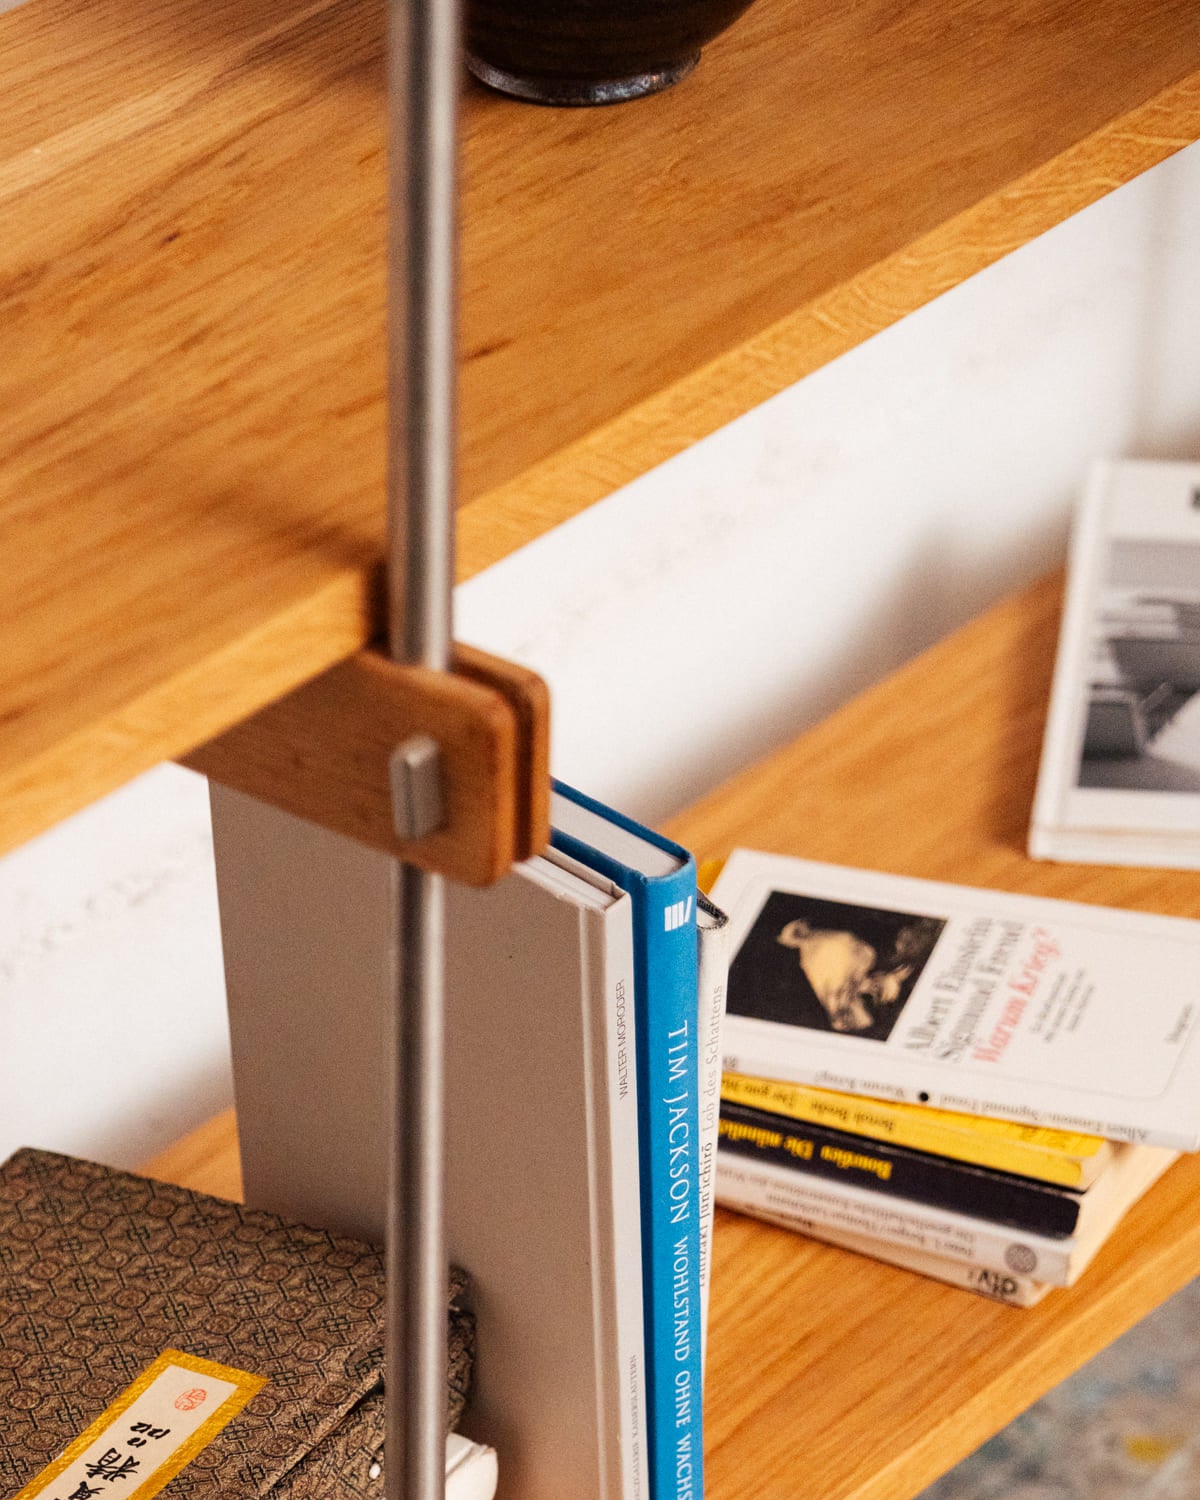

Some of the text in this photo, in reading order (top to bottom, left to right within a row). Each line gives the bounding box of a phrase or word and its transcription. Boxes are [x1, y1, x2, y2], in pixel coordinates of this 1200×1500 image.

[616, 978, 629, 1101] WALTER MORODER
[667, 1020, 688, 1083] TIM
[707, 984, 723, 1064] Schattens
[702, 1101, 714, 1132] Lob
[705, 1069, 717, 1097] des
[663, 1091, 691, 1224] JACKSON
[672, 1236, 691, 1362] WOHLSTAND
[674, 1370, 692, 1428] OHNE
